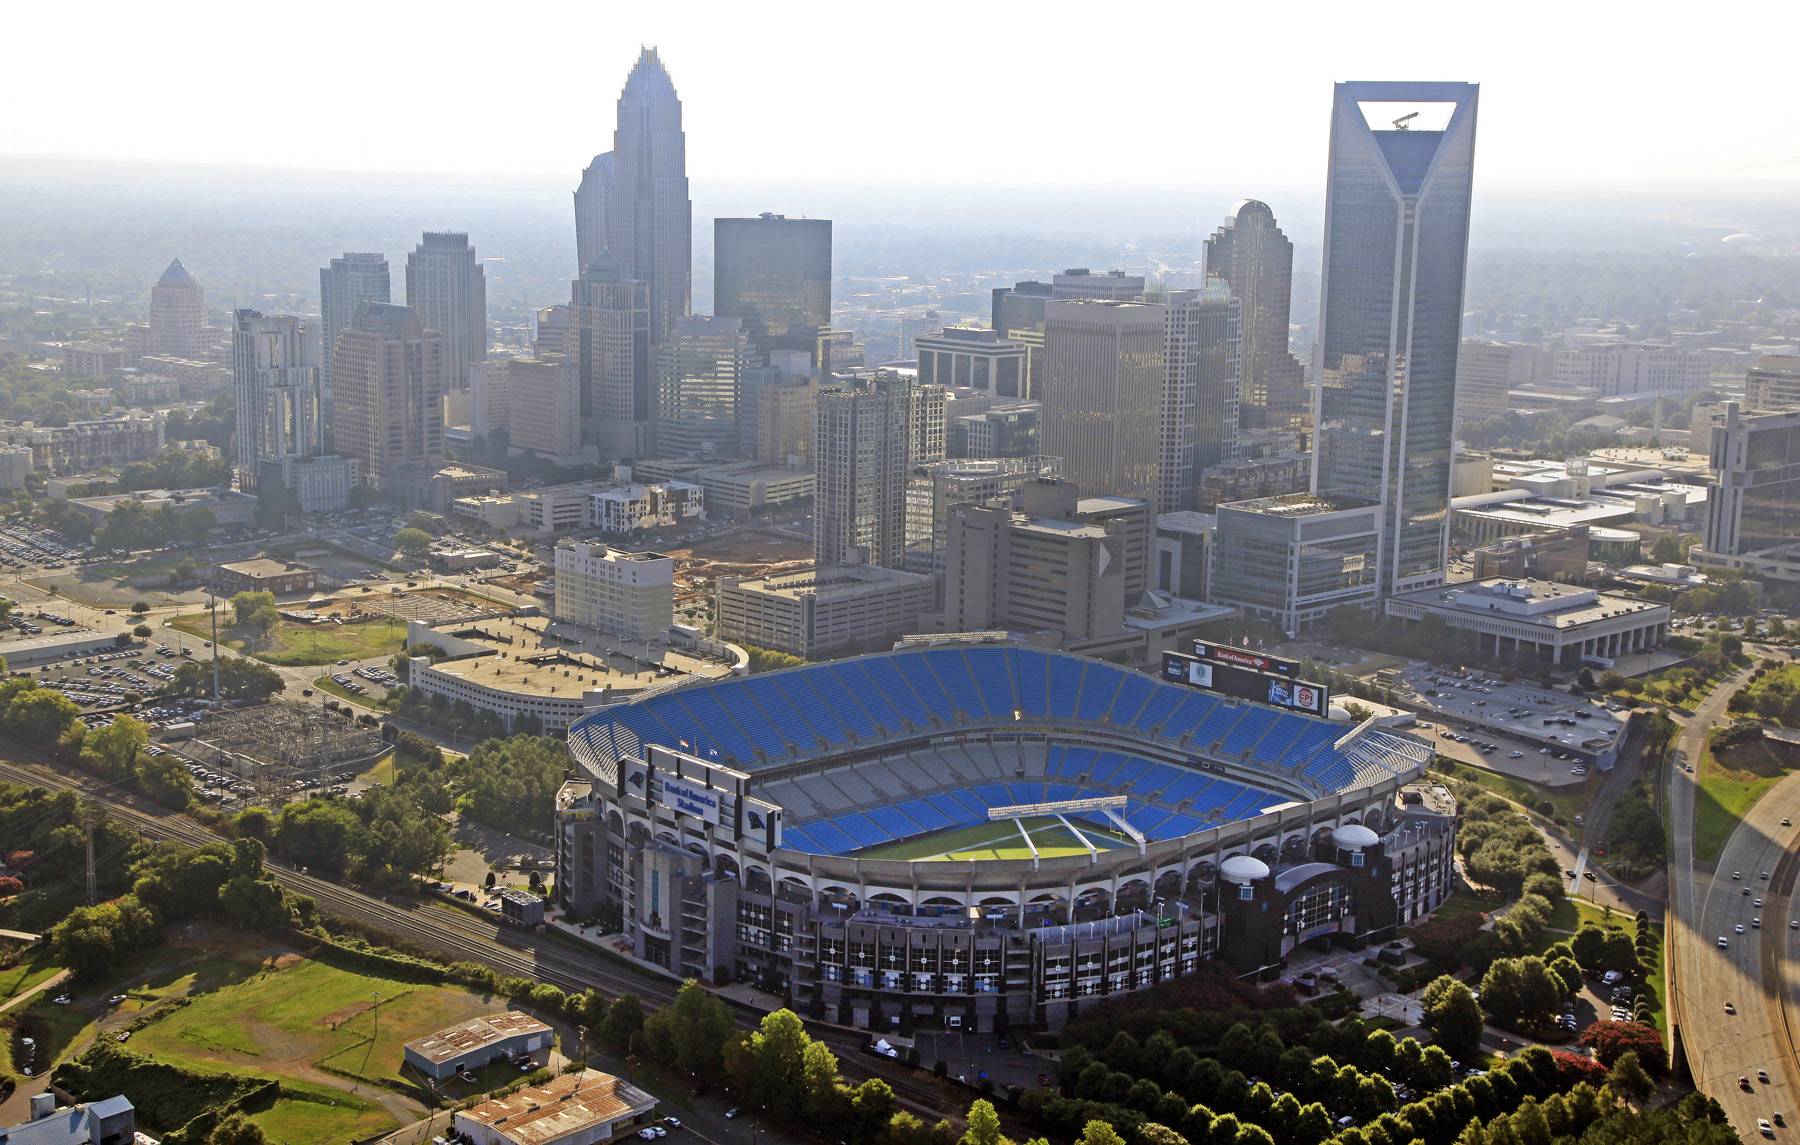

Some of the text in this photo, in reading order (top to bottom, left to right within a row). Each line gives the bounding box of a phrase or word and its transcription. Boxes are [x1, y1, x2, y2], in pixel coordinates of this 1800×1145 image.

[1217, 651, 1229, 660] Bank
[1233, 655, 1253, 664] America
[665, 782, 716, 808] Bank of America
[677, 798, 704, 815] Stadium
